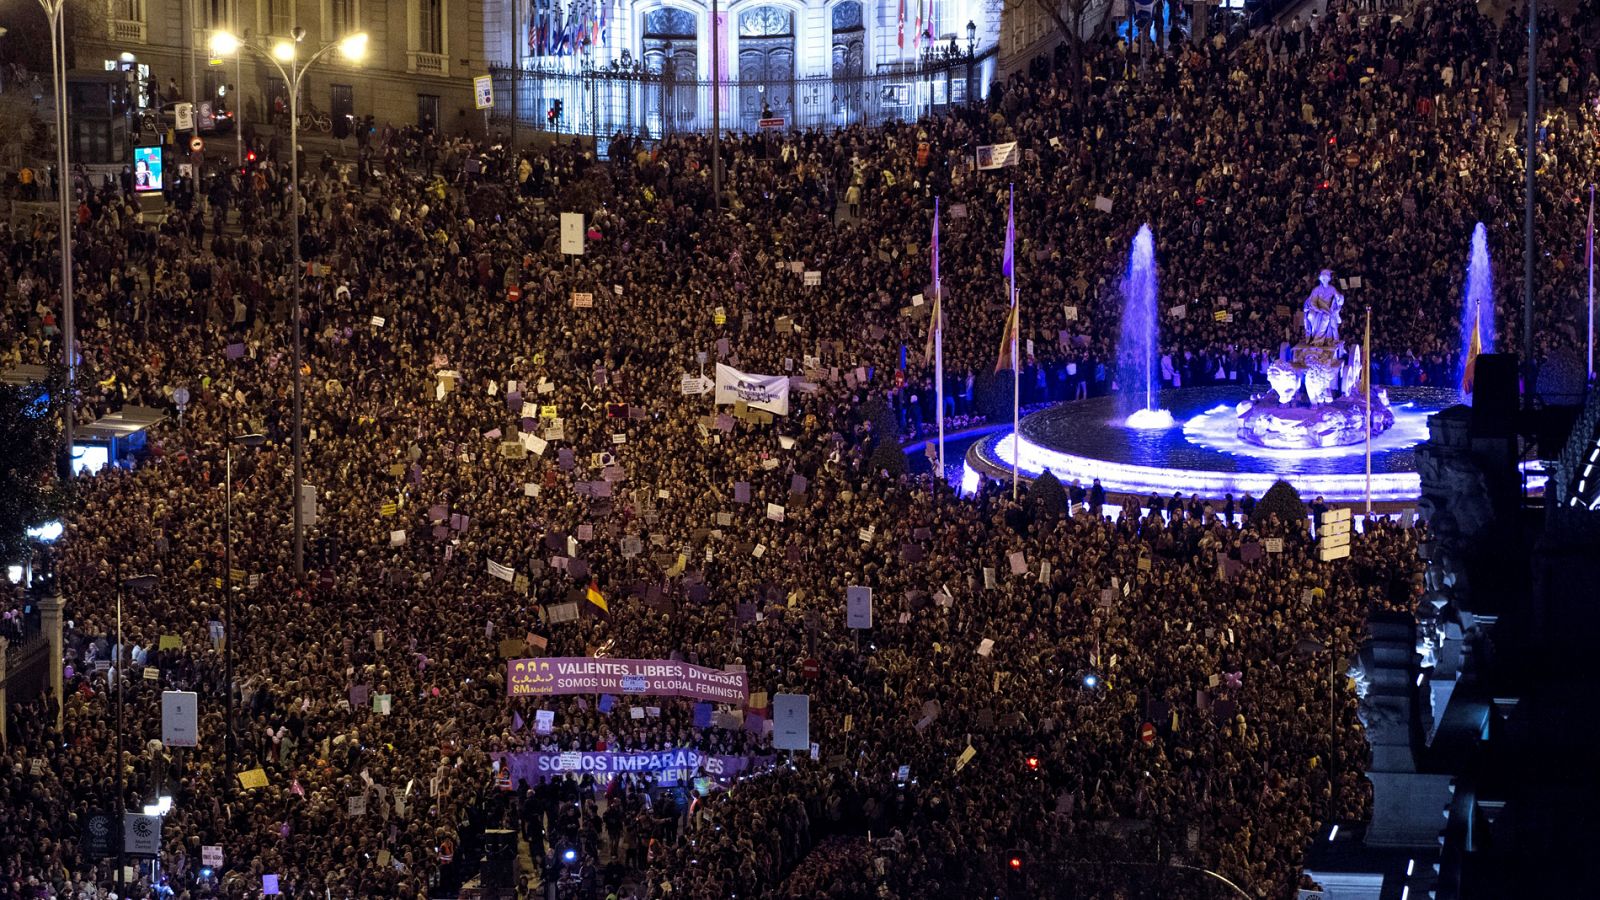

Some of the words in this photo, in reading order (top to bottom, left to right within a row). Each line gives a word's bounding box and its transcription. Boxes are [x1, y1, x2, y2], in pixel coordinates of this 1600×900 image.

[746, 95, 792, 106] CASA
[803, 96, 818, 105] DE
[557, 663, 632, 676] VALIENTES,
[636, 665, 685, 679] LIBRES,
[689, 668, 743, 687] DIVERSAS
[513, 684, 530, 694] 8M
[557, 678, 598, 688] SOMOS
[601, 679, 617, 687] UN
[654, 680, 693, 692] GLOBAL
[696, 683, 745, 700] FEMINISTA
[538, 755, 607, 771] SOOS
